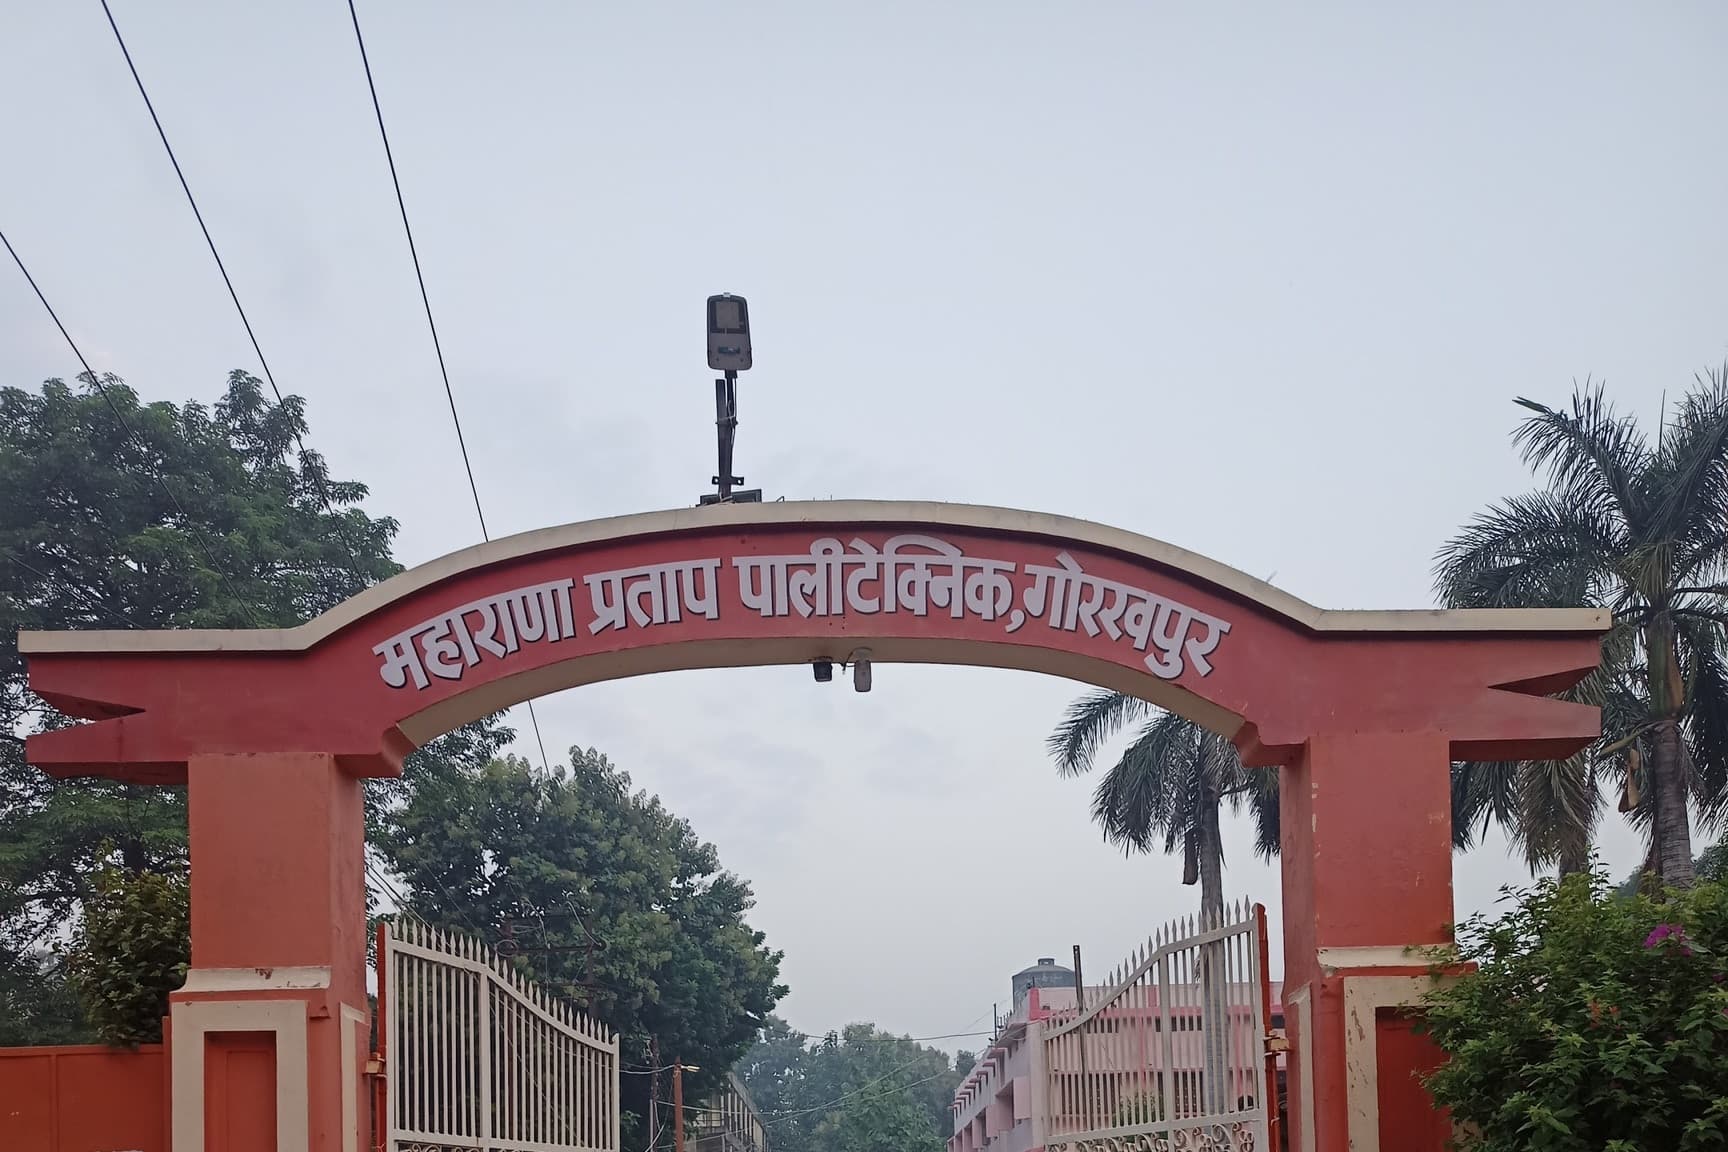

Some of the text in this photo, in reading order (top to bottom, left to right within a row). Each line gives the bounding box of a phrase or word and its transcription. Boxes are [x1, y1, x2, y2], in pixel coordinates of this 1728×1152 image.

[372, 578, 575, 690] महाराणा
[583, 557, 721, 635] प्रताप
[1023, 551, 1231, 679] गोरखपुर
